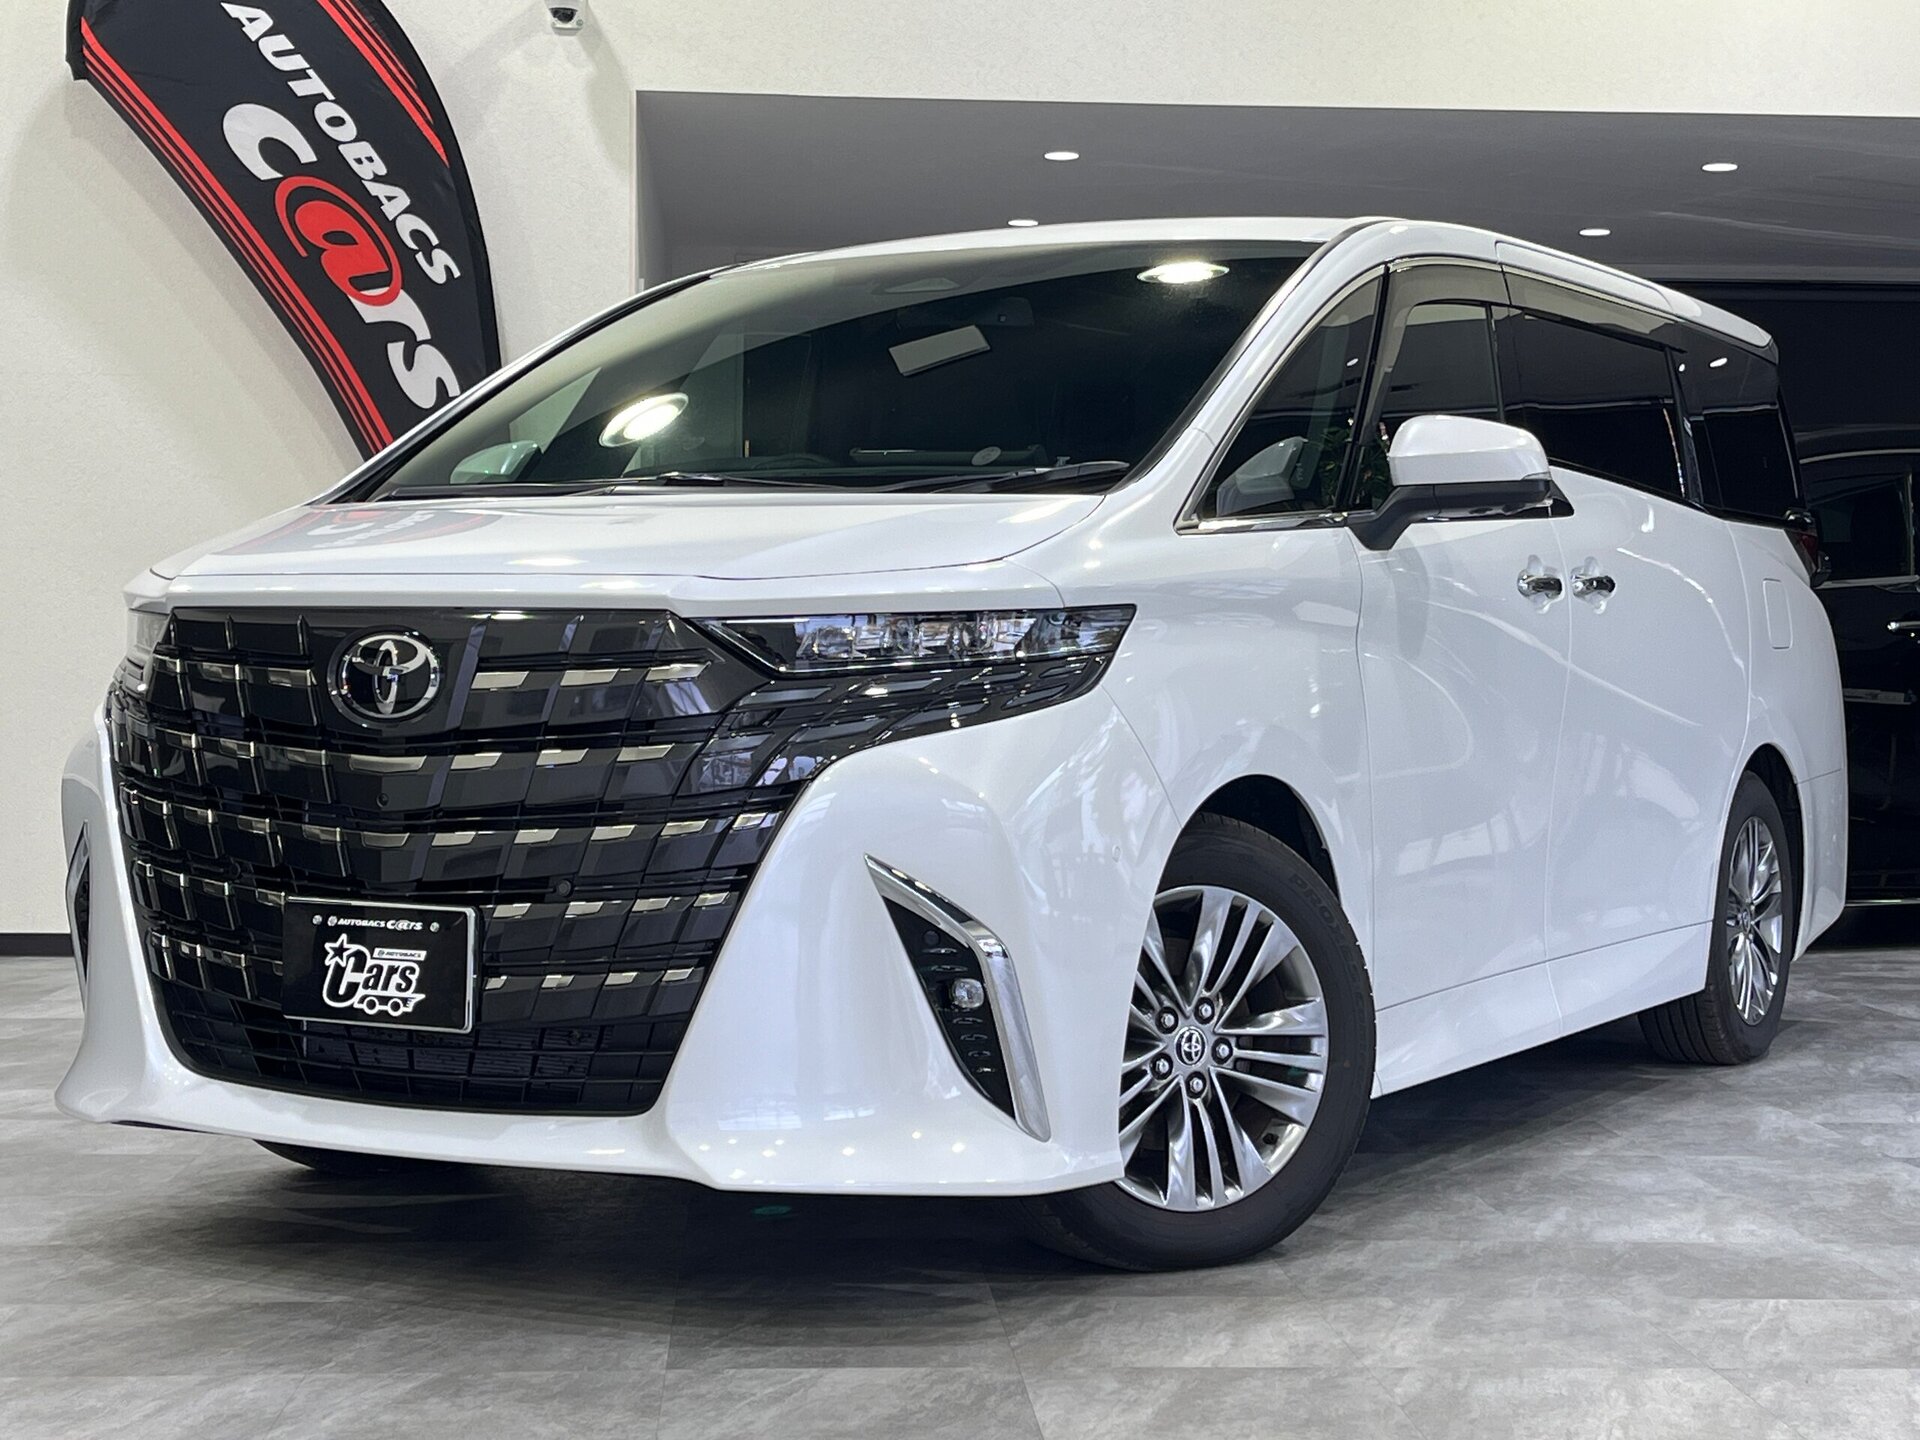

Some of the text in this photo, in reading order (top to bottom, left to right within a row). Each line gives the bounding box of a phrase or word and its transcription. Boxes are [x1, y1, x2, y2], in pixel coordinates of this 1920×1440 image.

[221, 2, 461, 284] AUTOBACS
[338, 917, 386, 928] AUTOBACS
[323, 945, 419, 1007] Cars
